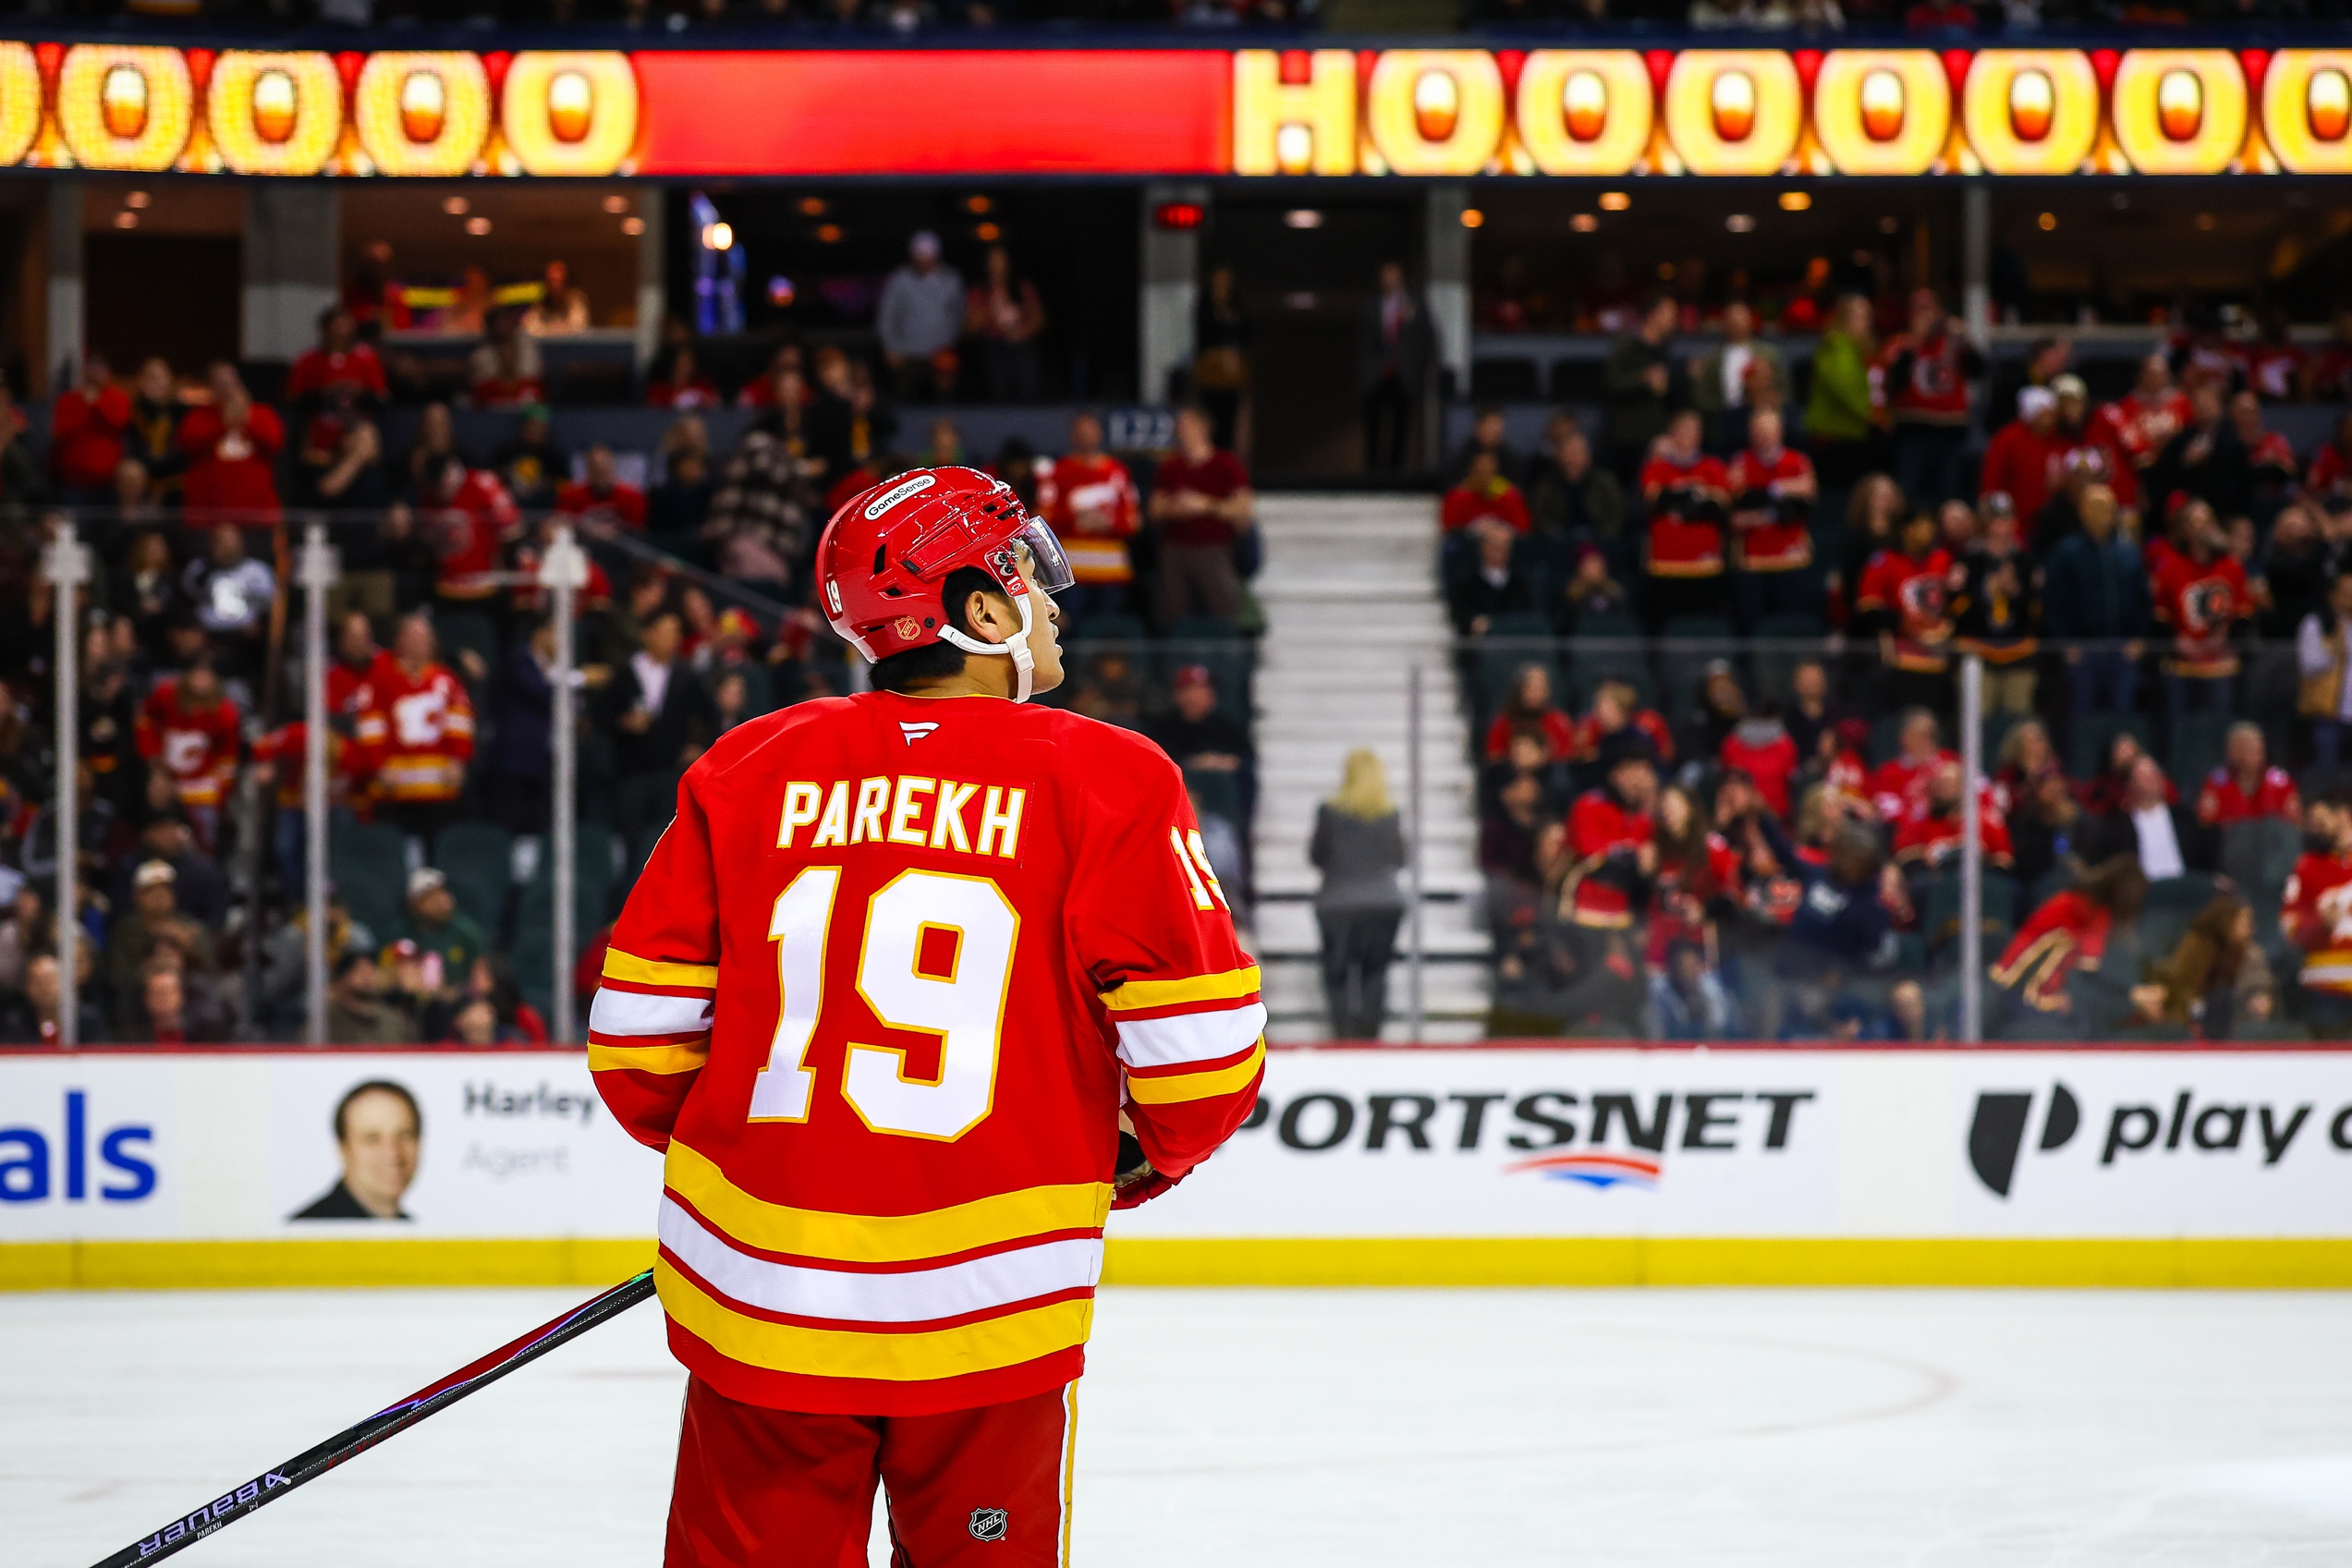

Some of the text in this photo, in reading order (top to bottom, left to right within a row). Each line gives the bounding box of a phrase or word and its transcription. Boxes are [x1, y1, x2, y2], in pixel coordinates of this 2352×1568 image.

[869, 479, 931, 516] GameSense
[776, 774, 1026, 859] PAREKH
[747, 865, 1021, 1143] 19
[463, 1079, 596, 1128] Harley
[2098, 1088, 2314, 1169] play
[0, 1090, 159, 1203] als
[196, 1520, 223, 1540] PAREKH
[977, 1515, 1000, 1533] NHL
